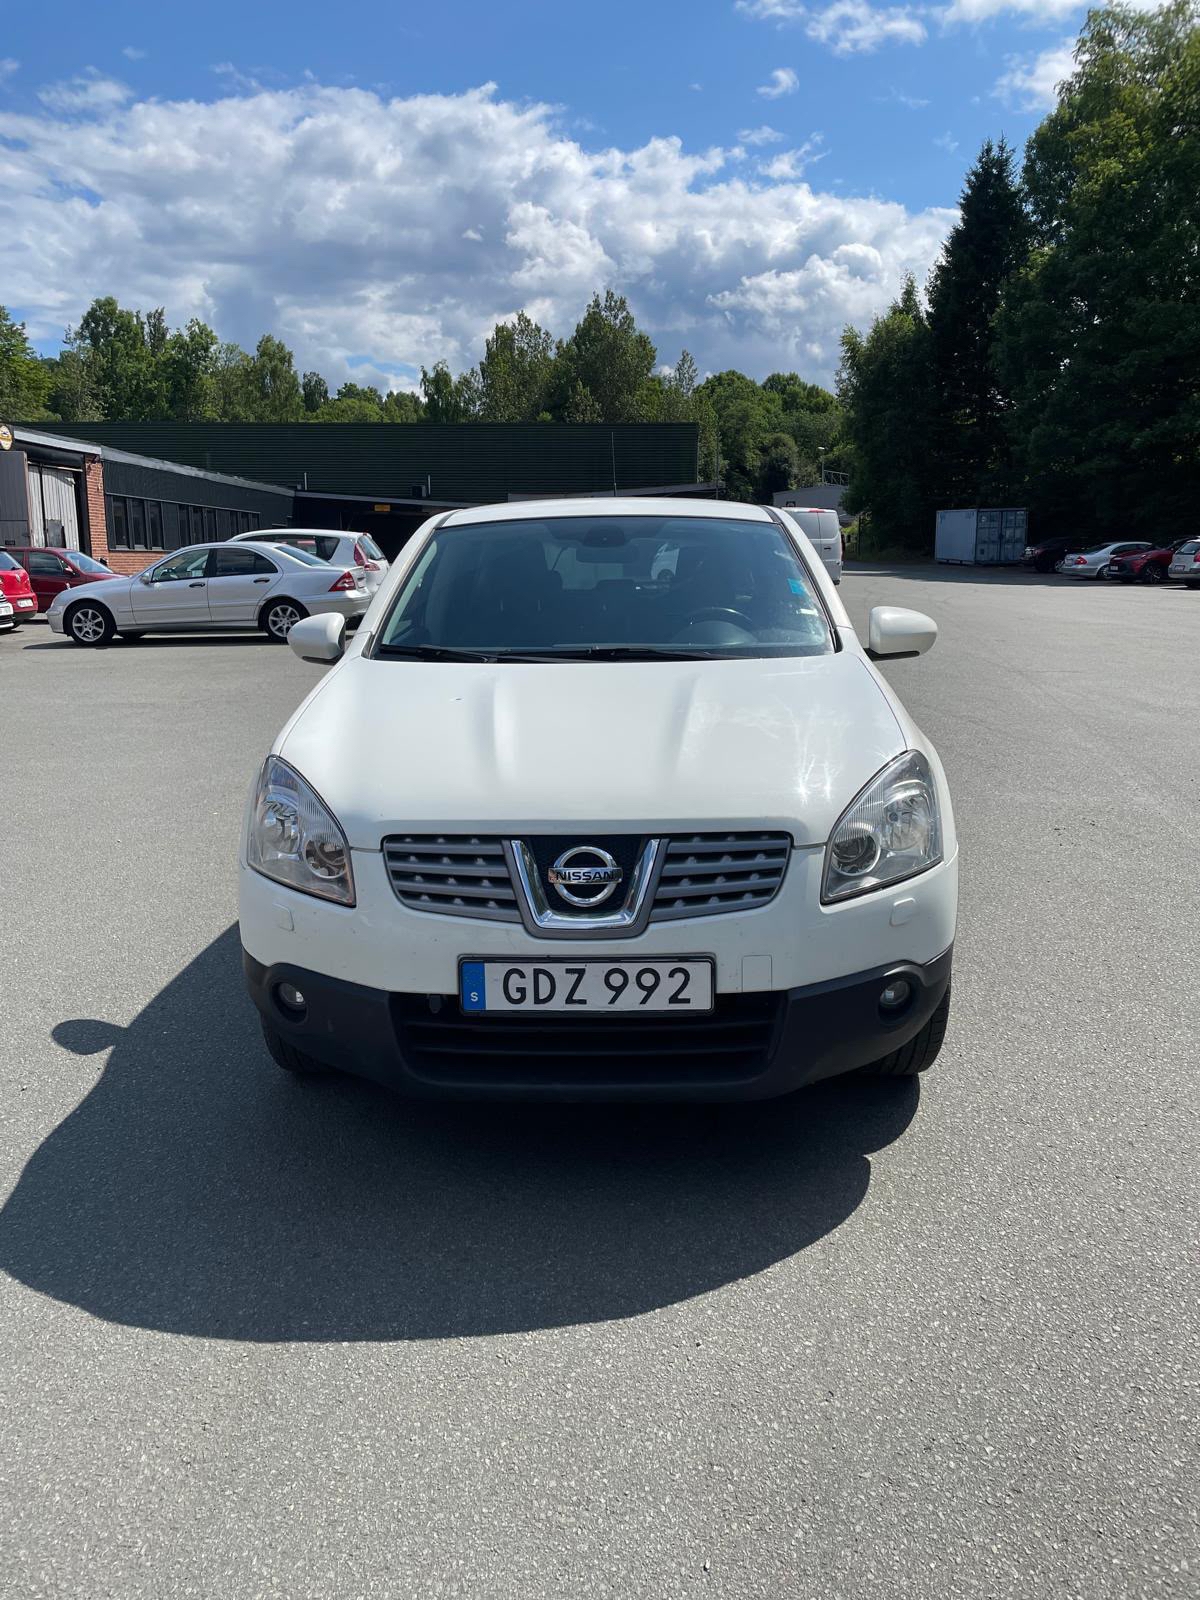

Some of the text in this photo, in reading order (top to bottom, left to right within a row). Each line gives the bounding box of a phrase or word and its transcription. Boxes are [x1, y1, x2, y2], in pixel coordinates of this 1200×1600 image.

[556, 871, 614, 881] NISSAN
[502, 967, 691, 1005] GDZ 992
[470, 991, 479, 1002] S
